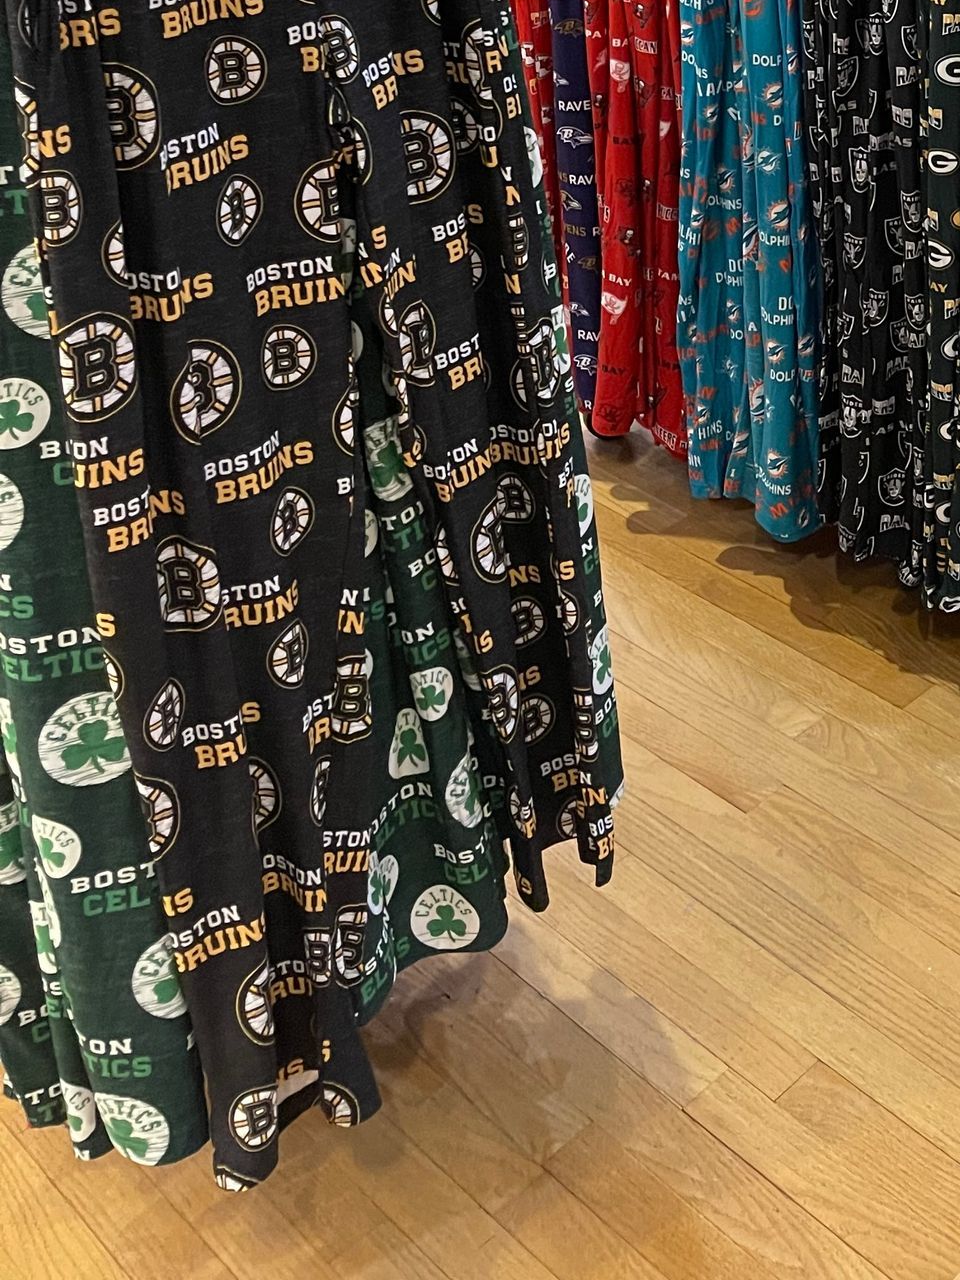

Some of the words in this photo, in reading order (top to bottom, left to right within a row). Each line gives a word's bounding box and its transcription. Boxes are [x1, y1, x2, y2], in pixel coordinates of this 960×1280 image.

[558, 100, 591, 112] RAVE
[246, 256, 333, 293] BOSTON
[609, 273, 632, 287] BAY
[254, 274, 347, 318] BRUIN
[434, 333, 480, 370] BOST
[203, 431, 281, 481] BOSTON
[215, 441, 314, 504] BRUINS
[93, 485, 150, 527] BOST
[224, 579, 299, 630] RUINS
[181, 715, 243, 747] BOST
[70, 861, 156, 894] BOST
[263, 854, 321, 886] OSTON
[262, 872, 327, 912] BRUIN
[413, 888, 472, 921] CELTICS
